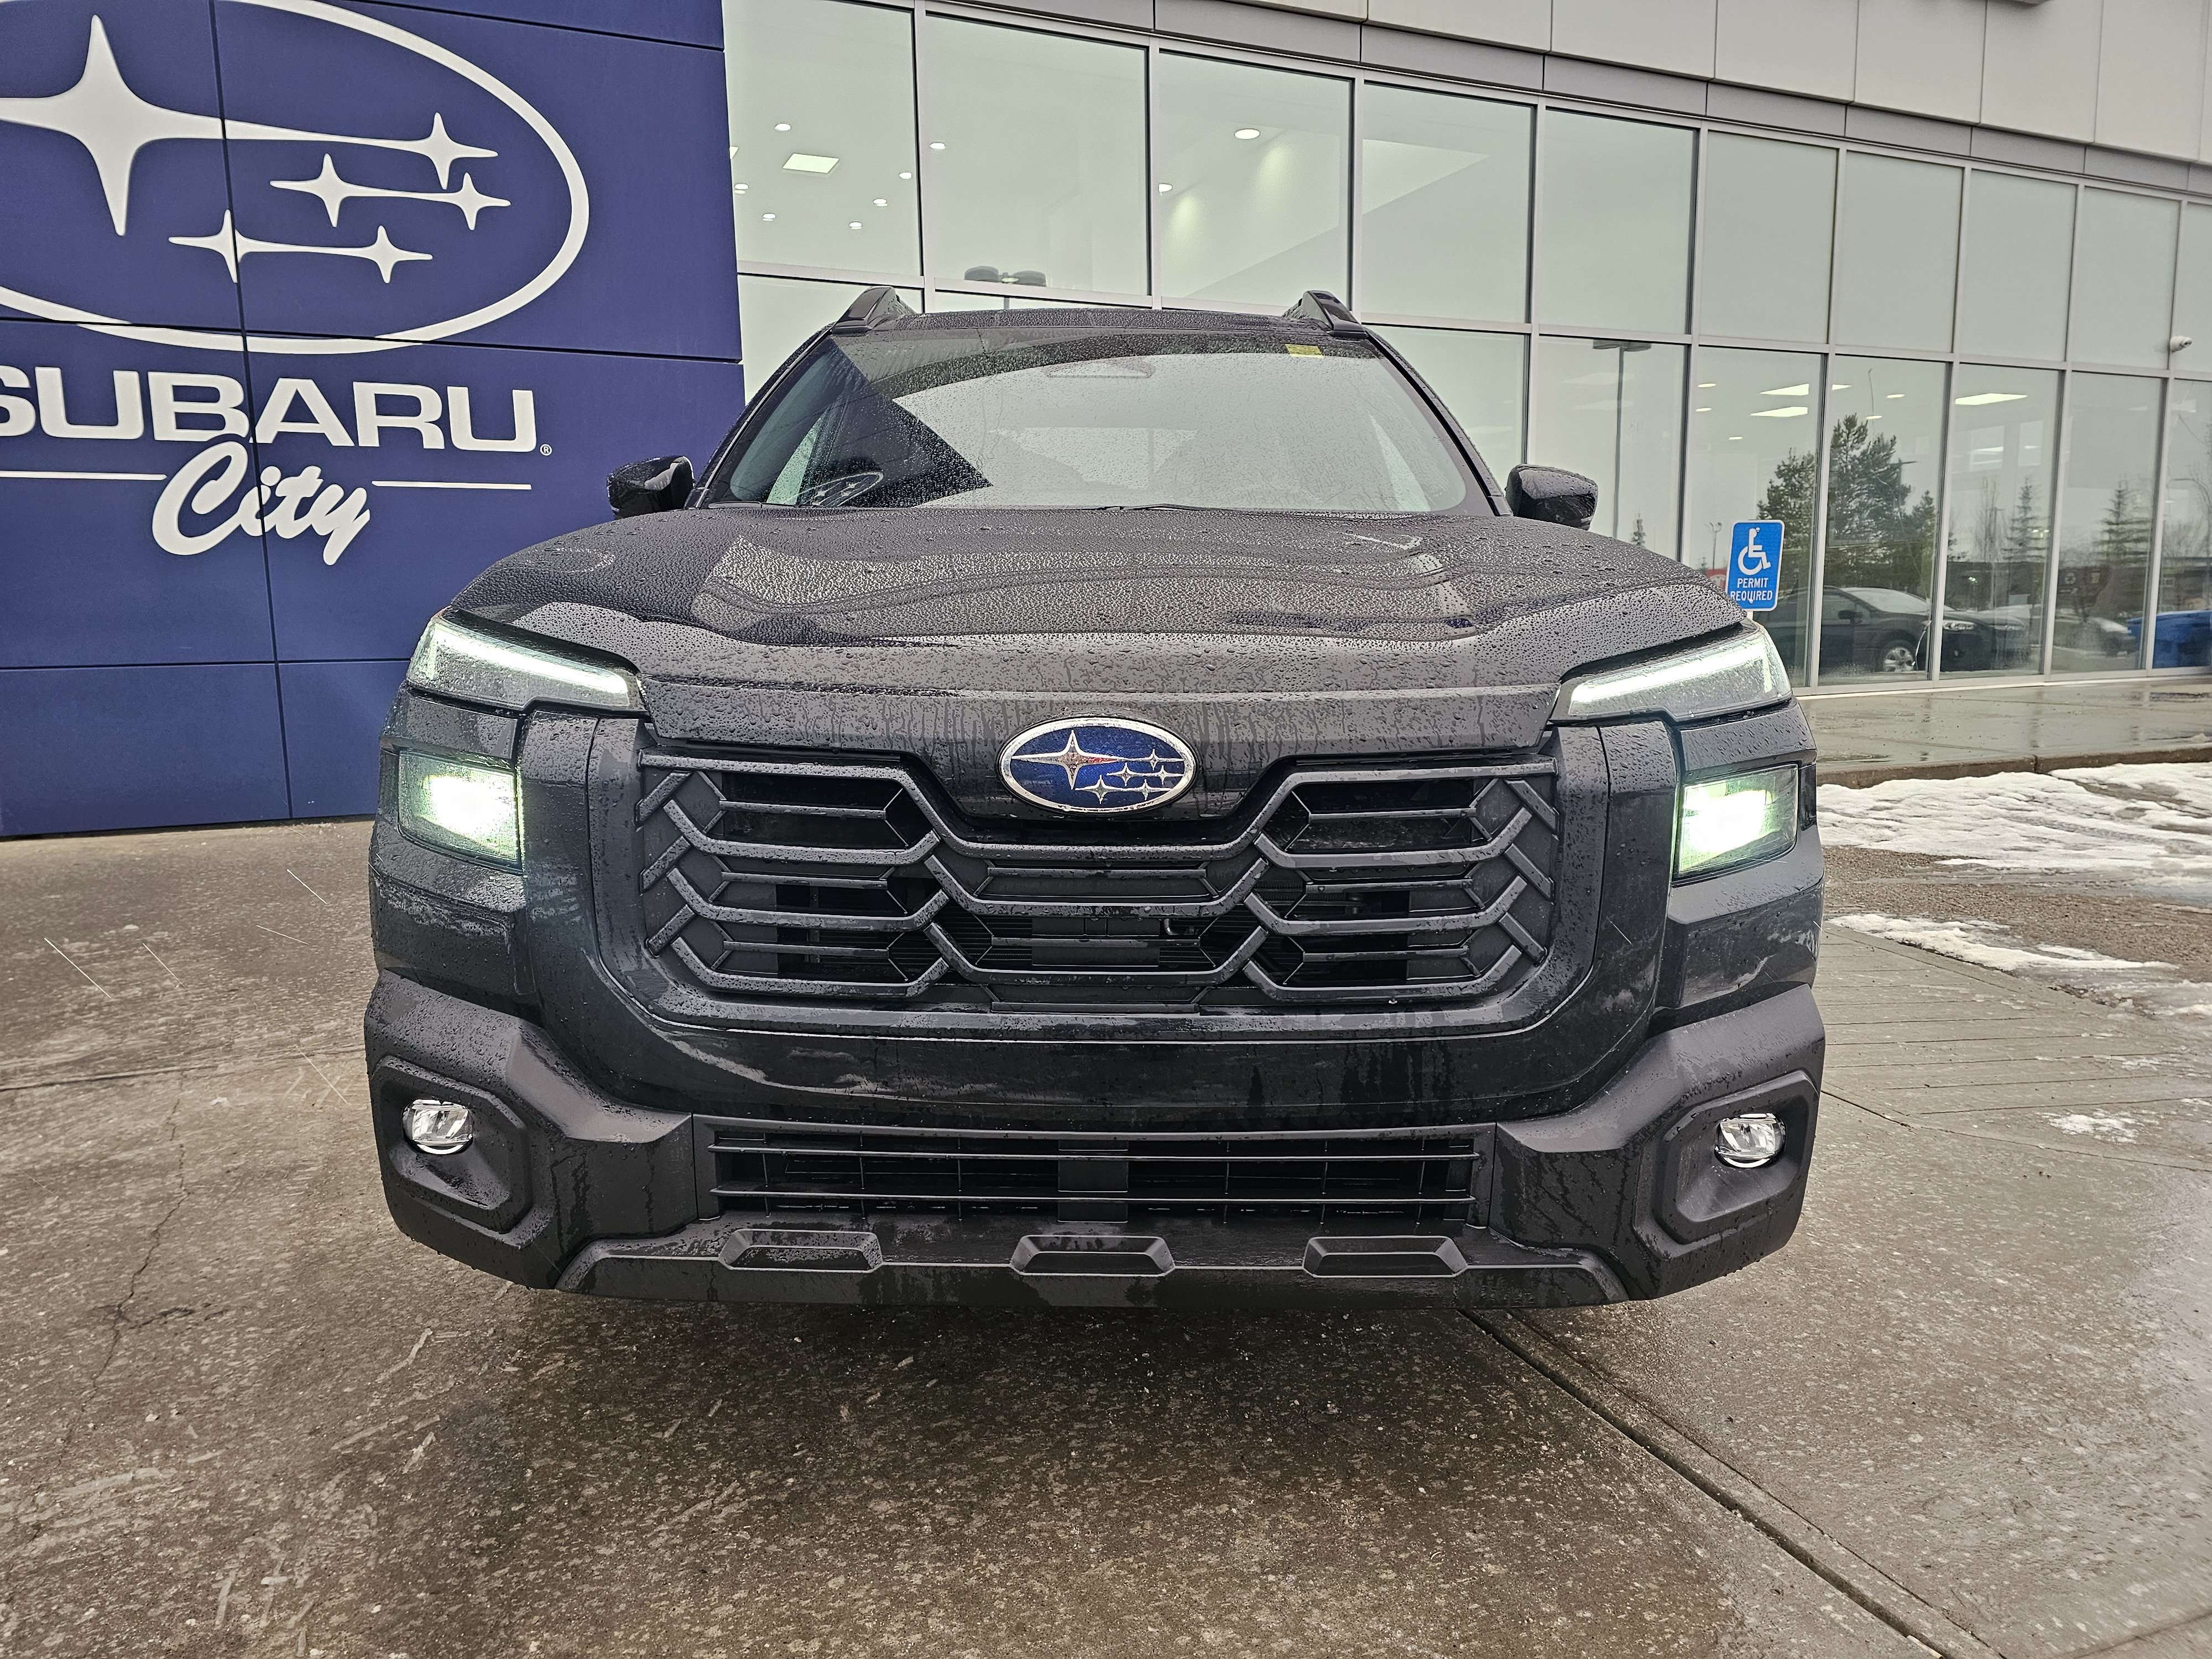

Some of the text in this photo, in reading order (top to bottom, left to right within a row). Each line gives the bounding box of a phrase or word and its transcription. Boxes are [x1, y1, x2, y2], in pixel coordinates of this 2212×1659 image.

[152, 441, 370, 566] City
[1737, 577, 1769, 588] PERMIT
[1730, 590, 1773, 601] REQUIRED
